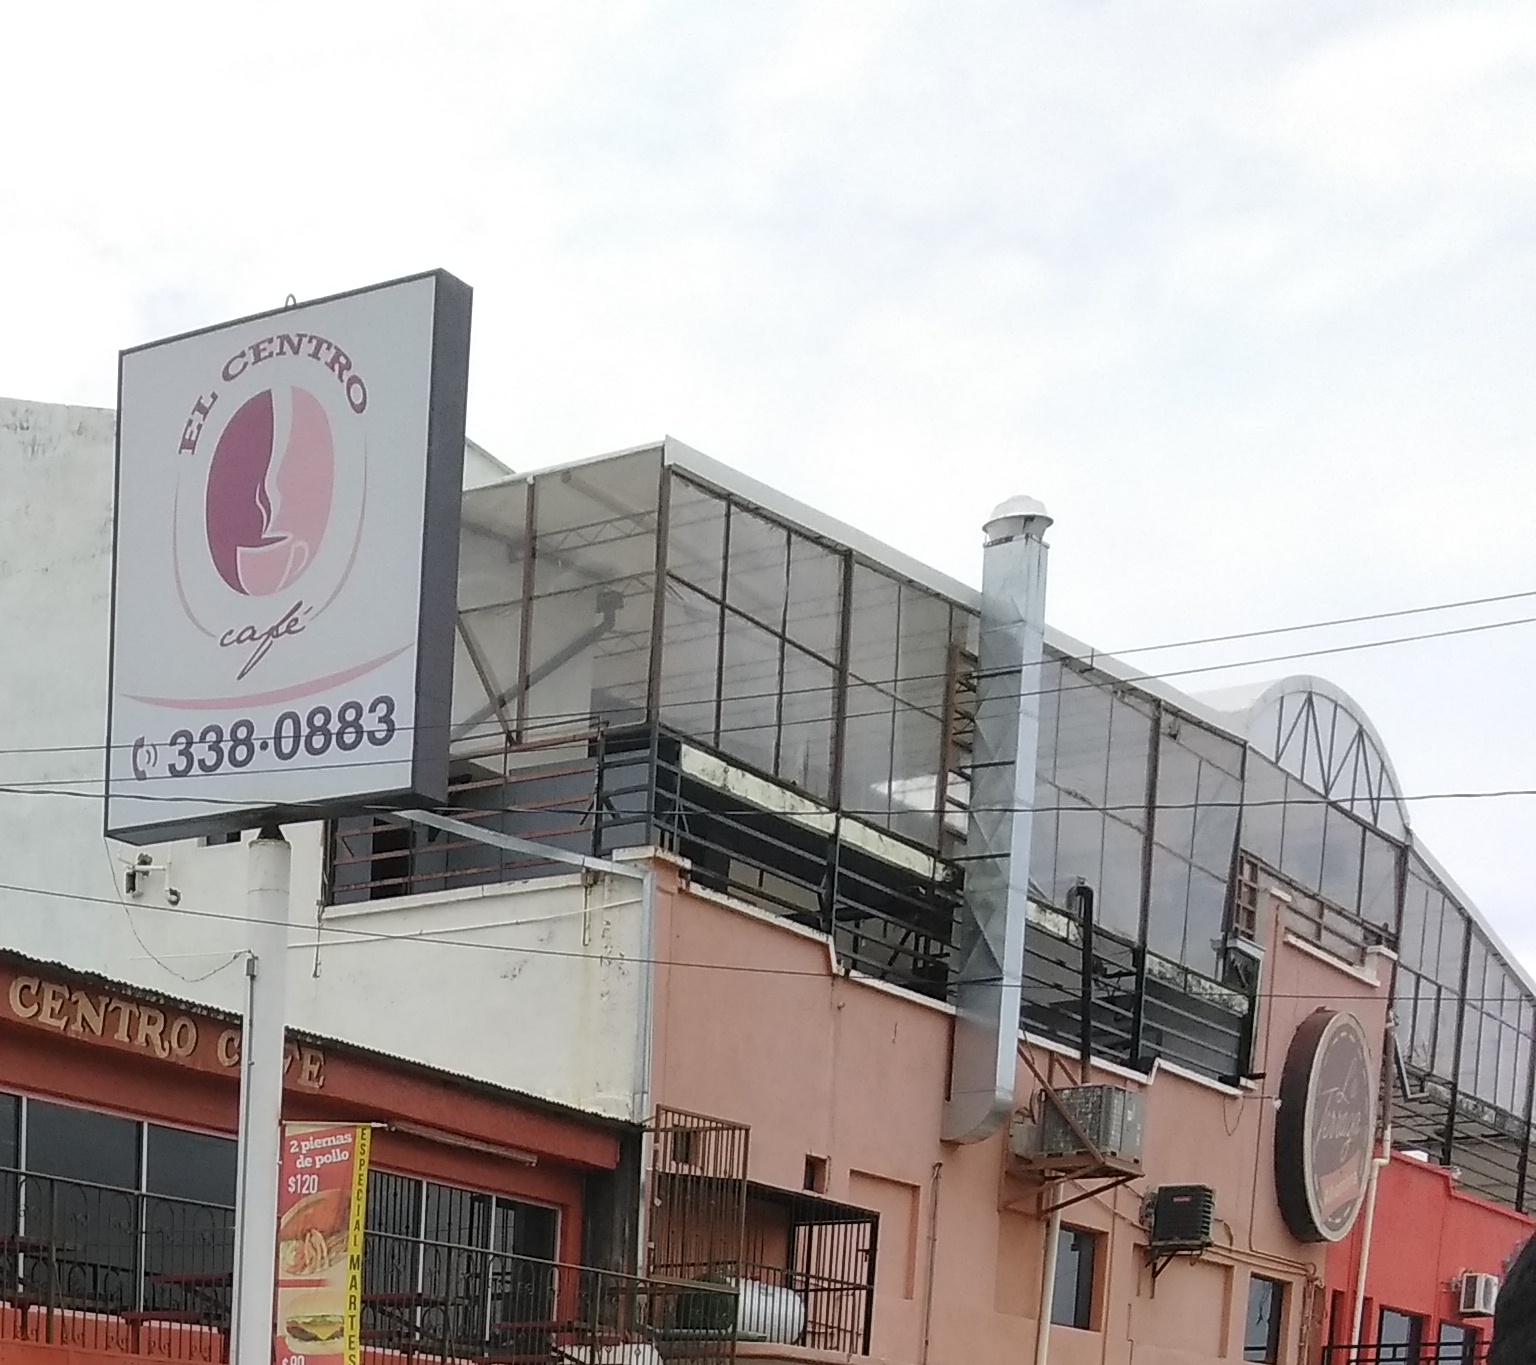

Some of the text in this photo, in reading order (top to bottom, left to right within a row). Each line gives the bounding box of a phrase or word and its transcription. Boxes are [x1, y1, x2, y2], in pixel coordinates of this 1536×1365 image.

[178, 333, 368, 456] EL CENTRO
[219, 601, 313, 681] café
[9, 975, 198, 1059] CENTRO
[287, 1173, 319, 1194] $120
[289, 1133, 353, 1154] 2 piernas
[296, 1148, 350, 1169] de pollo
[352, 1127, 367, 1248] ESPECIAL
